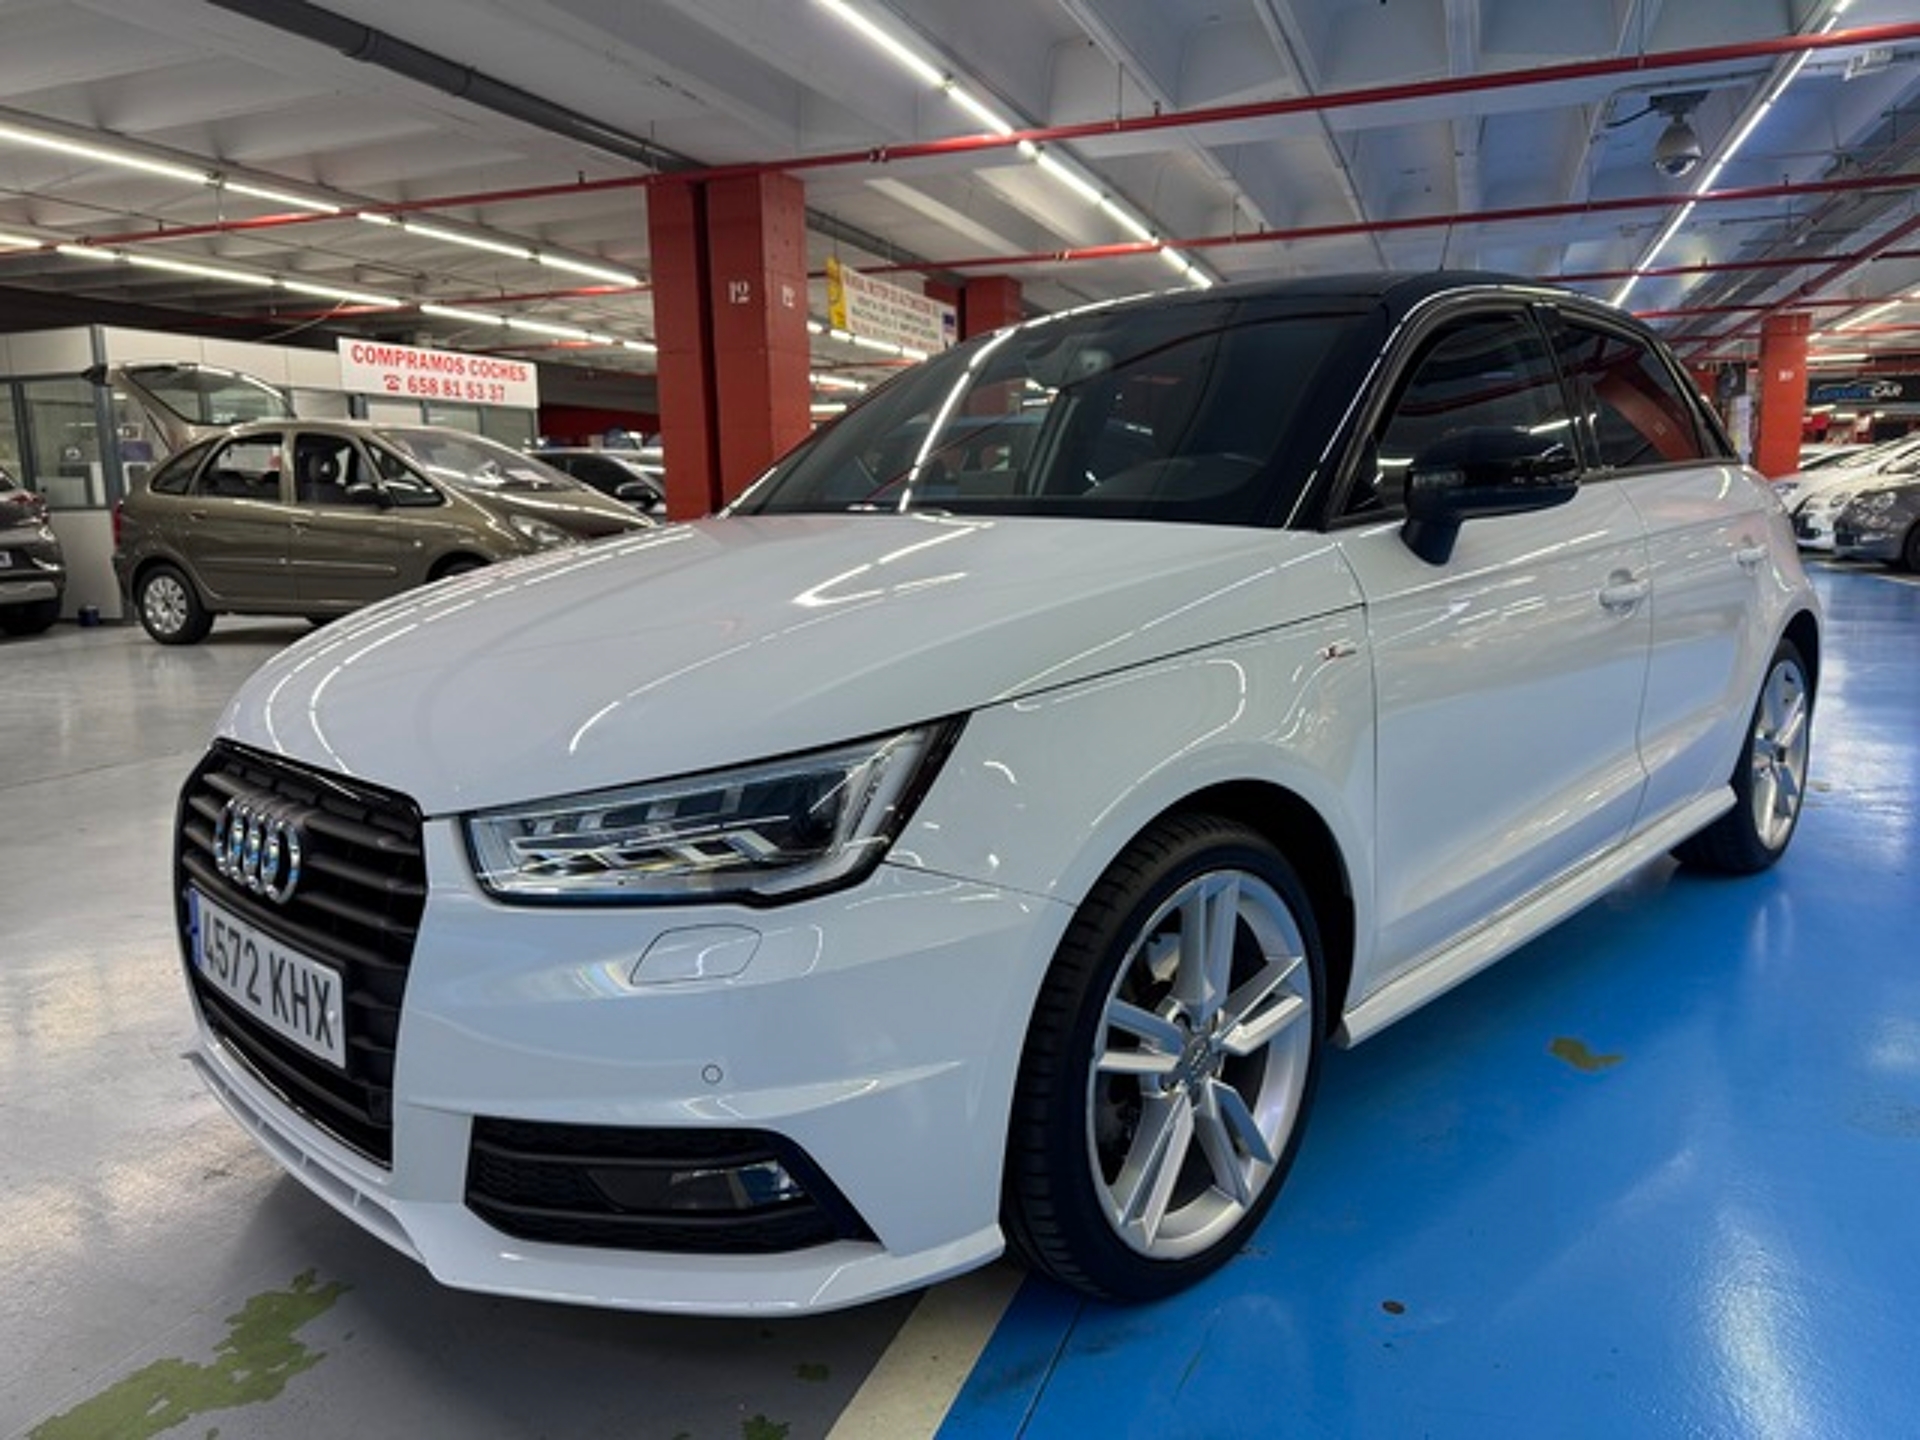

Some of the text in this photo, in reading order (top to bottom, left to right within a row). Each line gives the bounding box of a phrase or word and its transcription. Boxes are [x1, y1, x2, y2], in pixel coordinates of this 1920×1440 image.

[351, 344, 528, 382] COMPRAMOS COCHES
[407, 375, 438, 395] 658
[203, 911, 334, 1049] 4572 KHX
